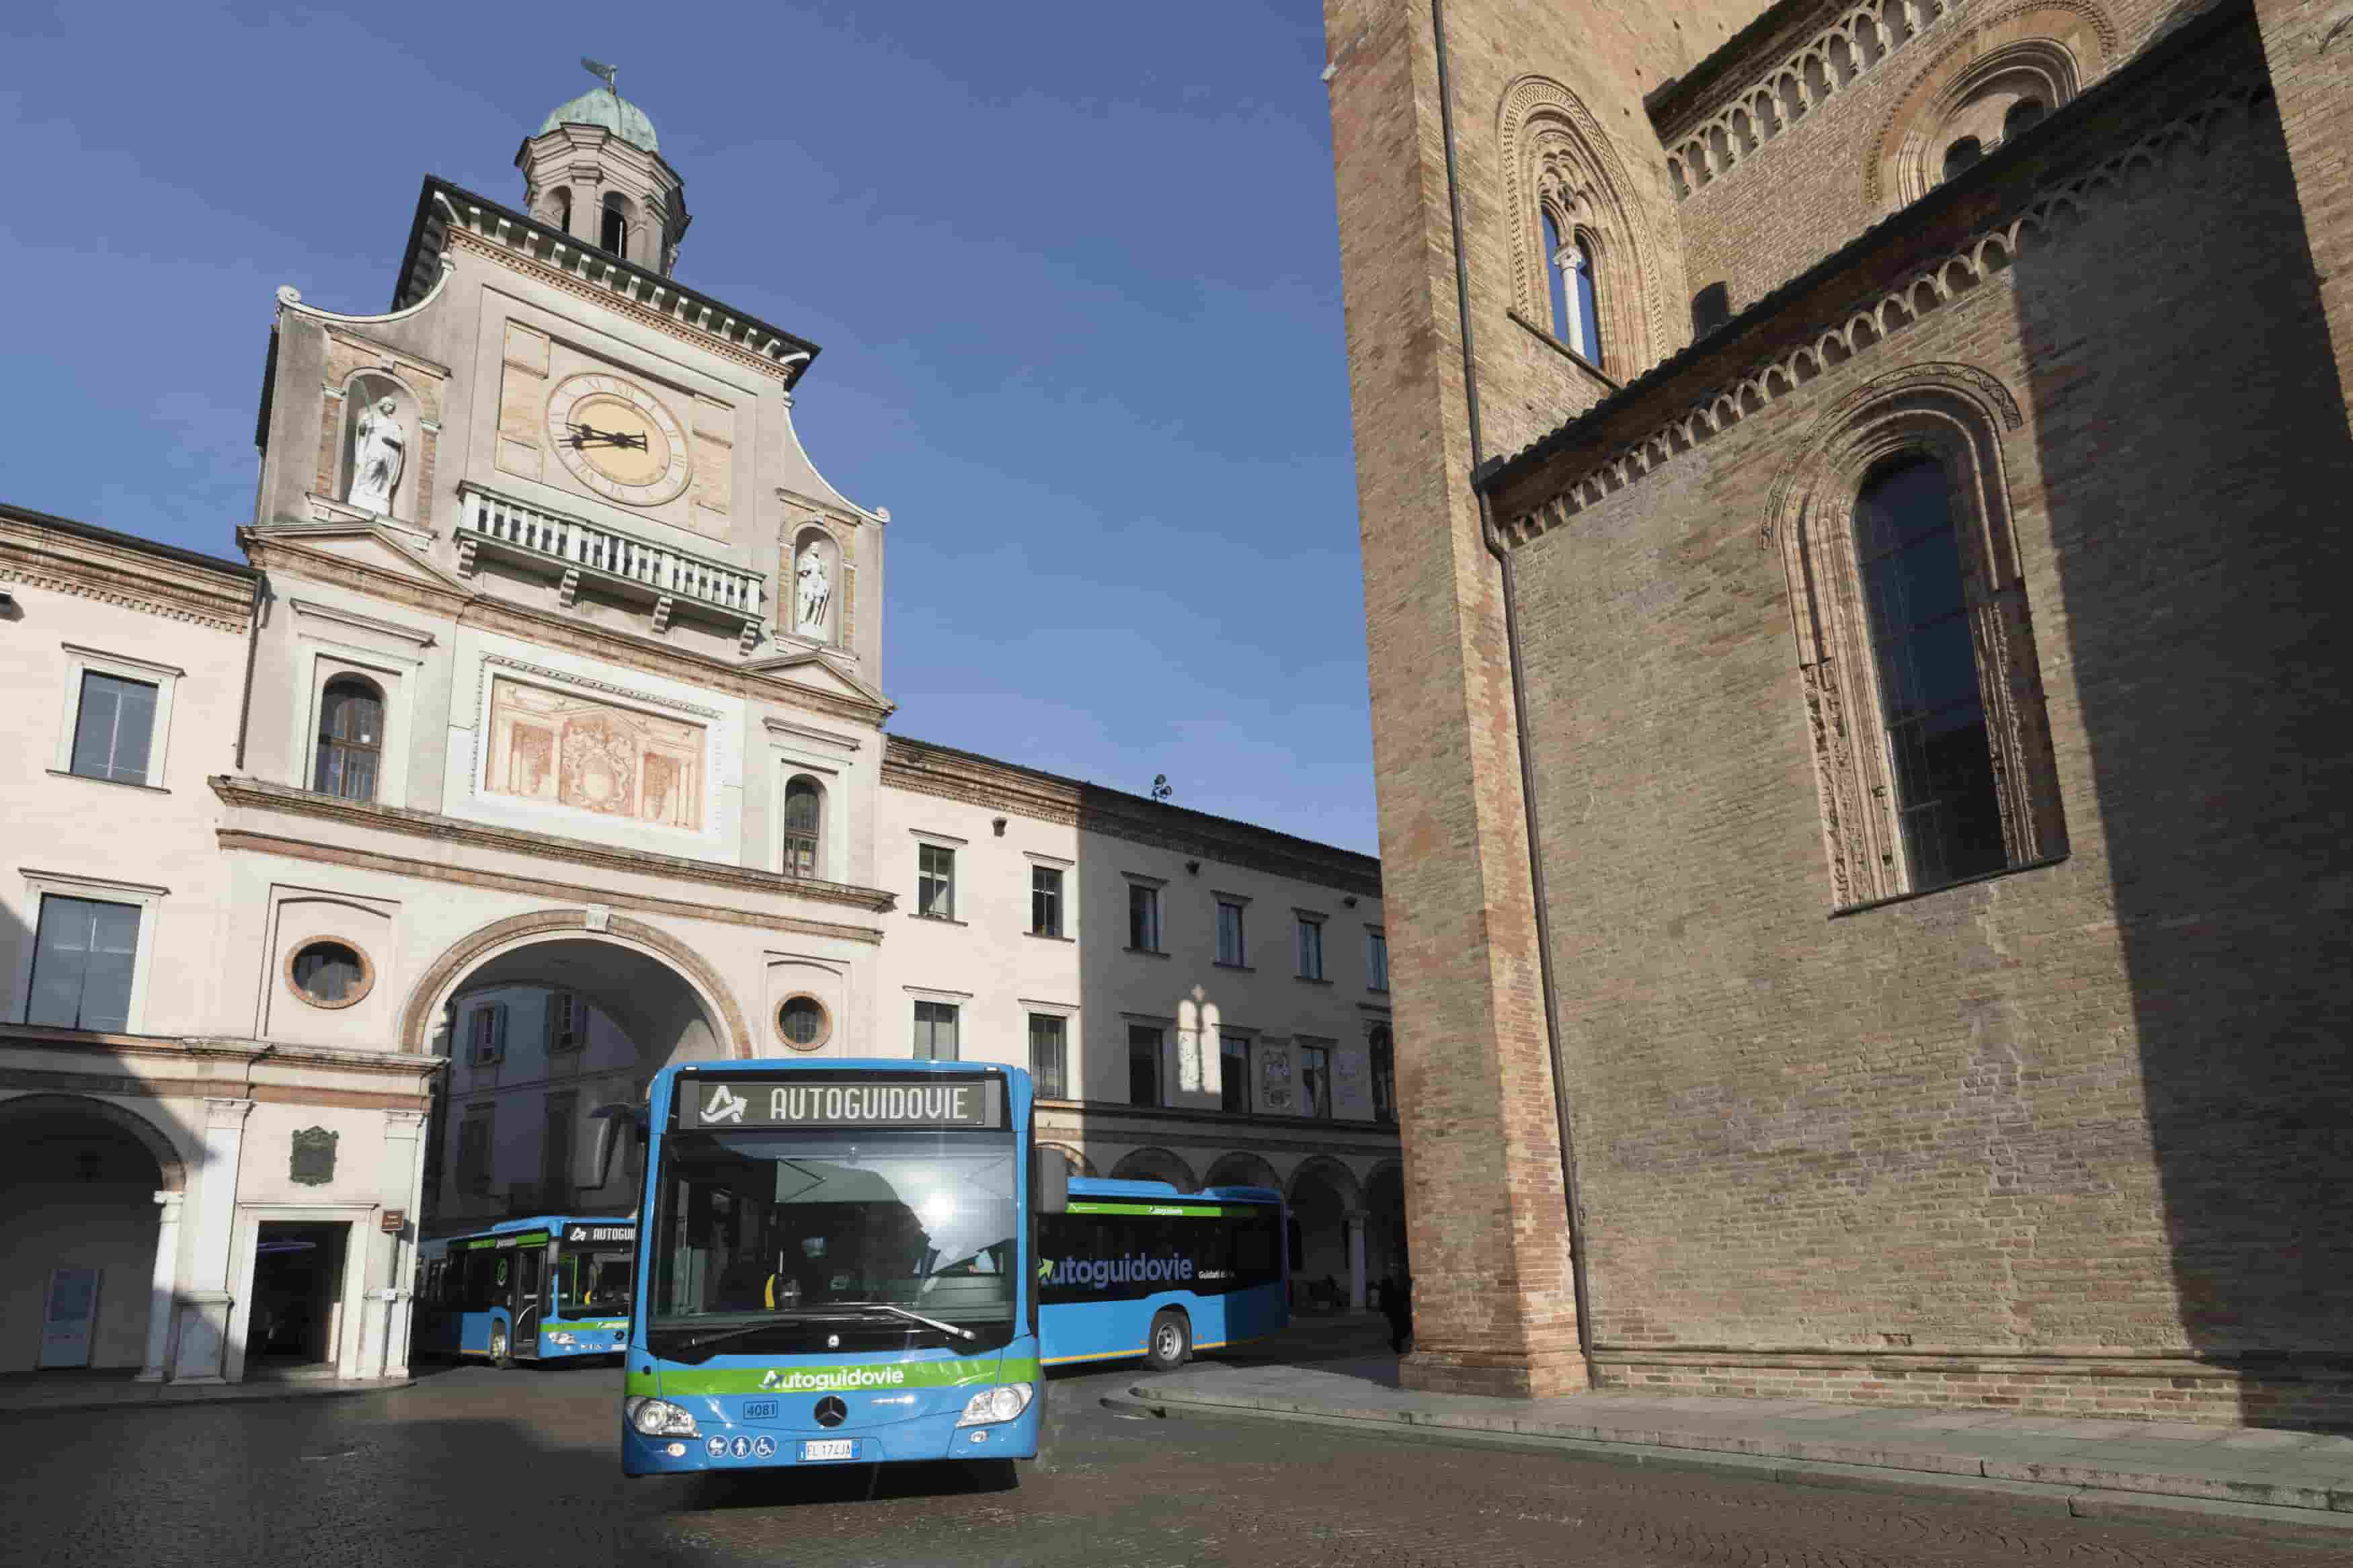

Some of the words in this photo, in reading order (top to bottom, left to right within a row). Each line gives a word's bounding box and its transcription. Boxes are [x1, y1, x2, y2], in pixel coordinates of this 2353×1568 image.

[770, 1087, 969, 1120] AUTOGUIDOVIE
[593, 1227, 635, 1241] AUTOGUI
[758, 1366, 904, 1389] Autoguidovie
[747, 1403, 776, 1417] 4081
